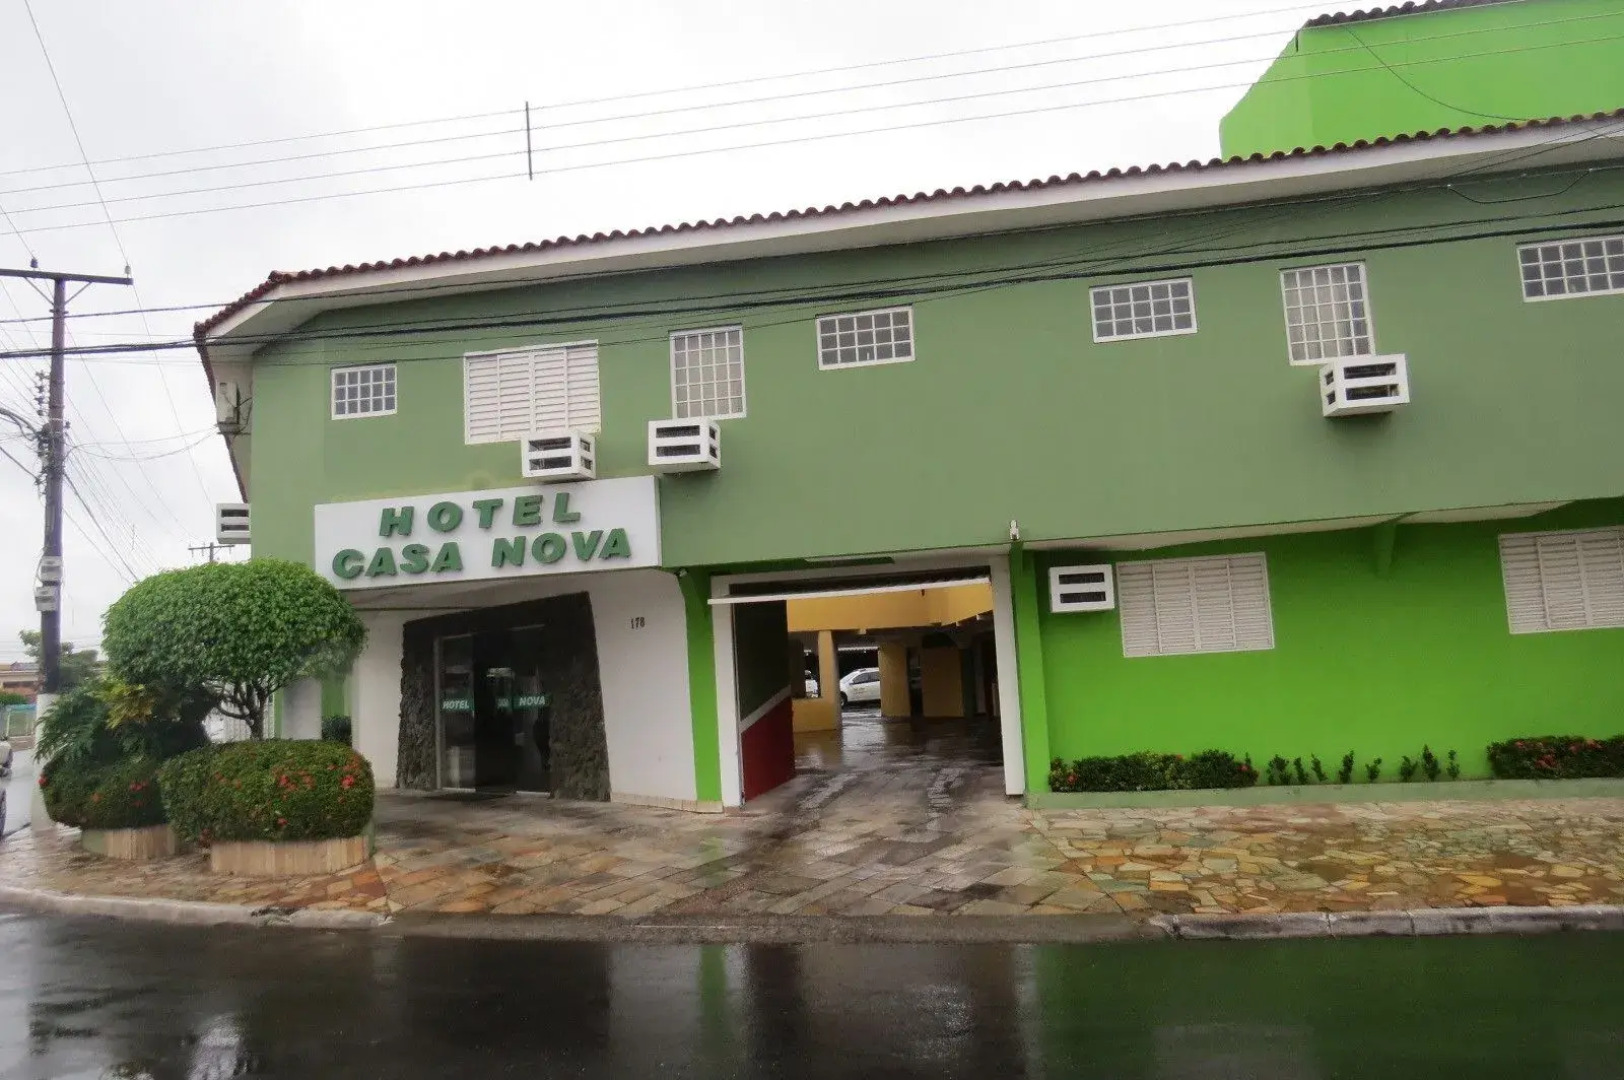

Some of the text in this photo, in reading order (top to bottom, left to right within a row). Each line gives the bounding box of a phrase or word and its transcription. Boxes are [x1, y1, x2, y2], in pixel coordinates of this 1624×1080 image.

[379, 492, 581, 537] HOTEL
[332, 528, 632, 579] CASA NOVA
[630, 616, 645, 629] 178
[442, 700, 470, 710] HOTEL
[519, 696, 546, 706] NOVA
